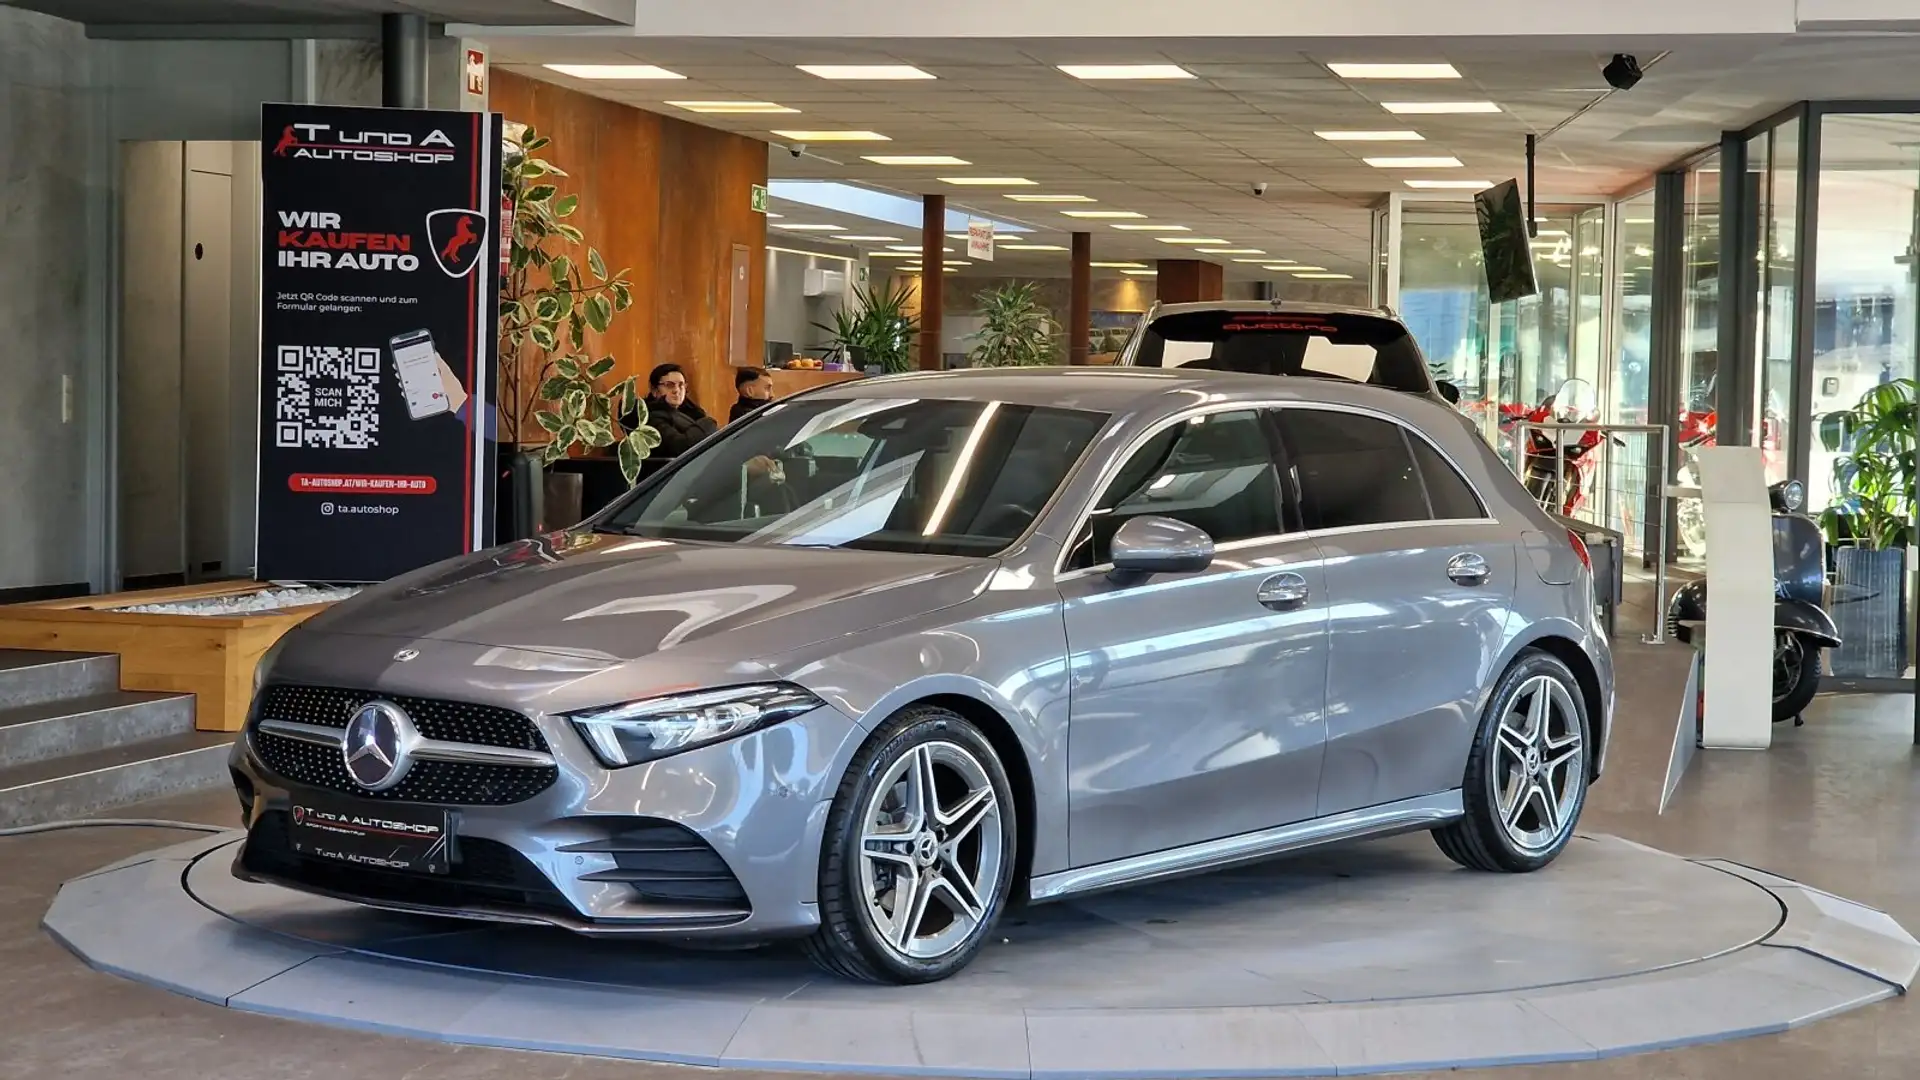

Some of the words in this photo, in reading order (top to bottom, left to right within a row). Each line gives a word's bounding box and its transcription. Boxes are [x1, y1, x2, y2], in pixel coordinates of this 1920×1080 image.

[293, 123, 330, 141] T
[419, 129, 455, 148] A
[293, 147, 455, 164] AUTOSHOP
[278, 210, 341, 230] WIR
[278, 230, 411, 251] KAUFEN
[277, 251, 332, 269] IHR
[334, 252, 420, 272] AUTO
[276, 291, 298, 301] Jetzt
[300, 292, 315, 302] QR
[315, 292, 339, 302] Code
[340, 294, 377, 303] scannen
[379, 295, 397, 304] und
[398, 296, 418, 304] zum
[276, 302, 317, 311] Formular
[318, 302, 363, 313] gelangen:
[1222, 322, 1338, 333] quattro
[314, 387, 343, 398] SCAN
[314, 398, 343, 408] MICH
[338, 505, 399, 515] ta.autoshop
[305, 807, 315, 816] T
[338, 813, 349, 823] A
[352, 816, 439, 833] AUTOSHOP
[314, 847, 323, 855] T
[336, 851, 344, 860] A
[347, 854, 410, 868] AUTOSHOP
